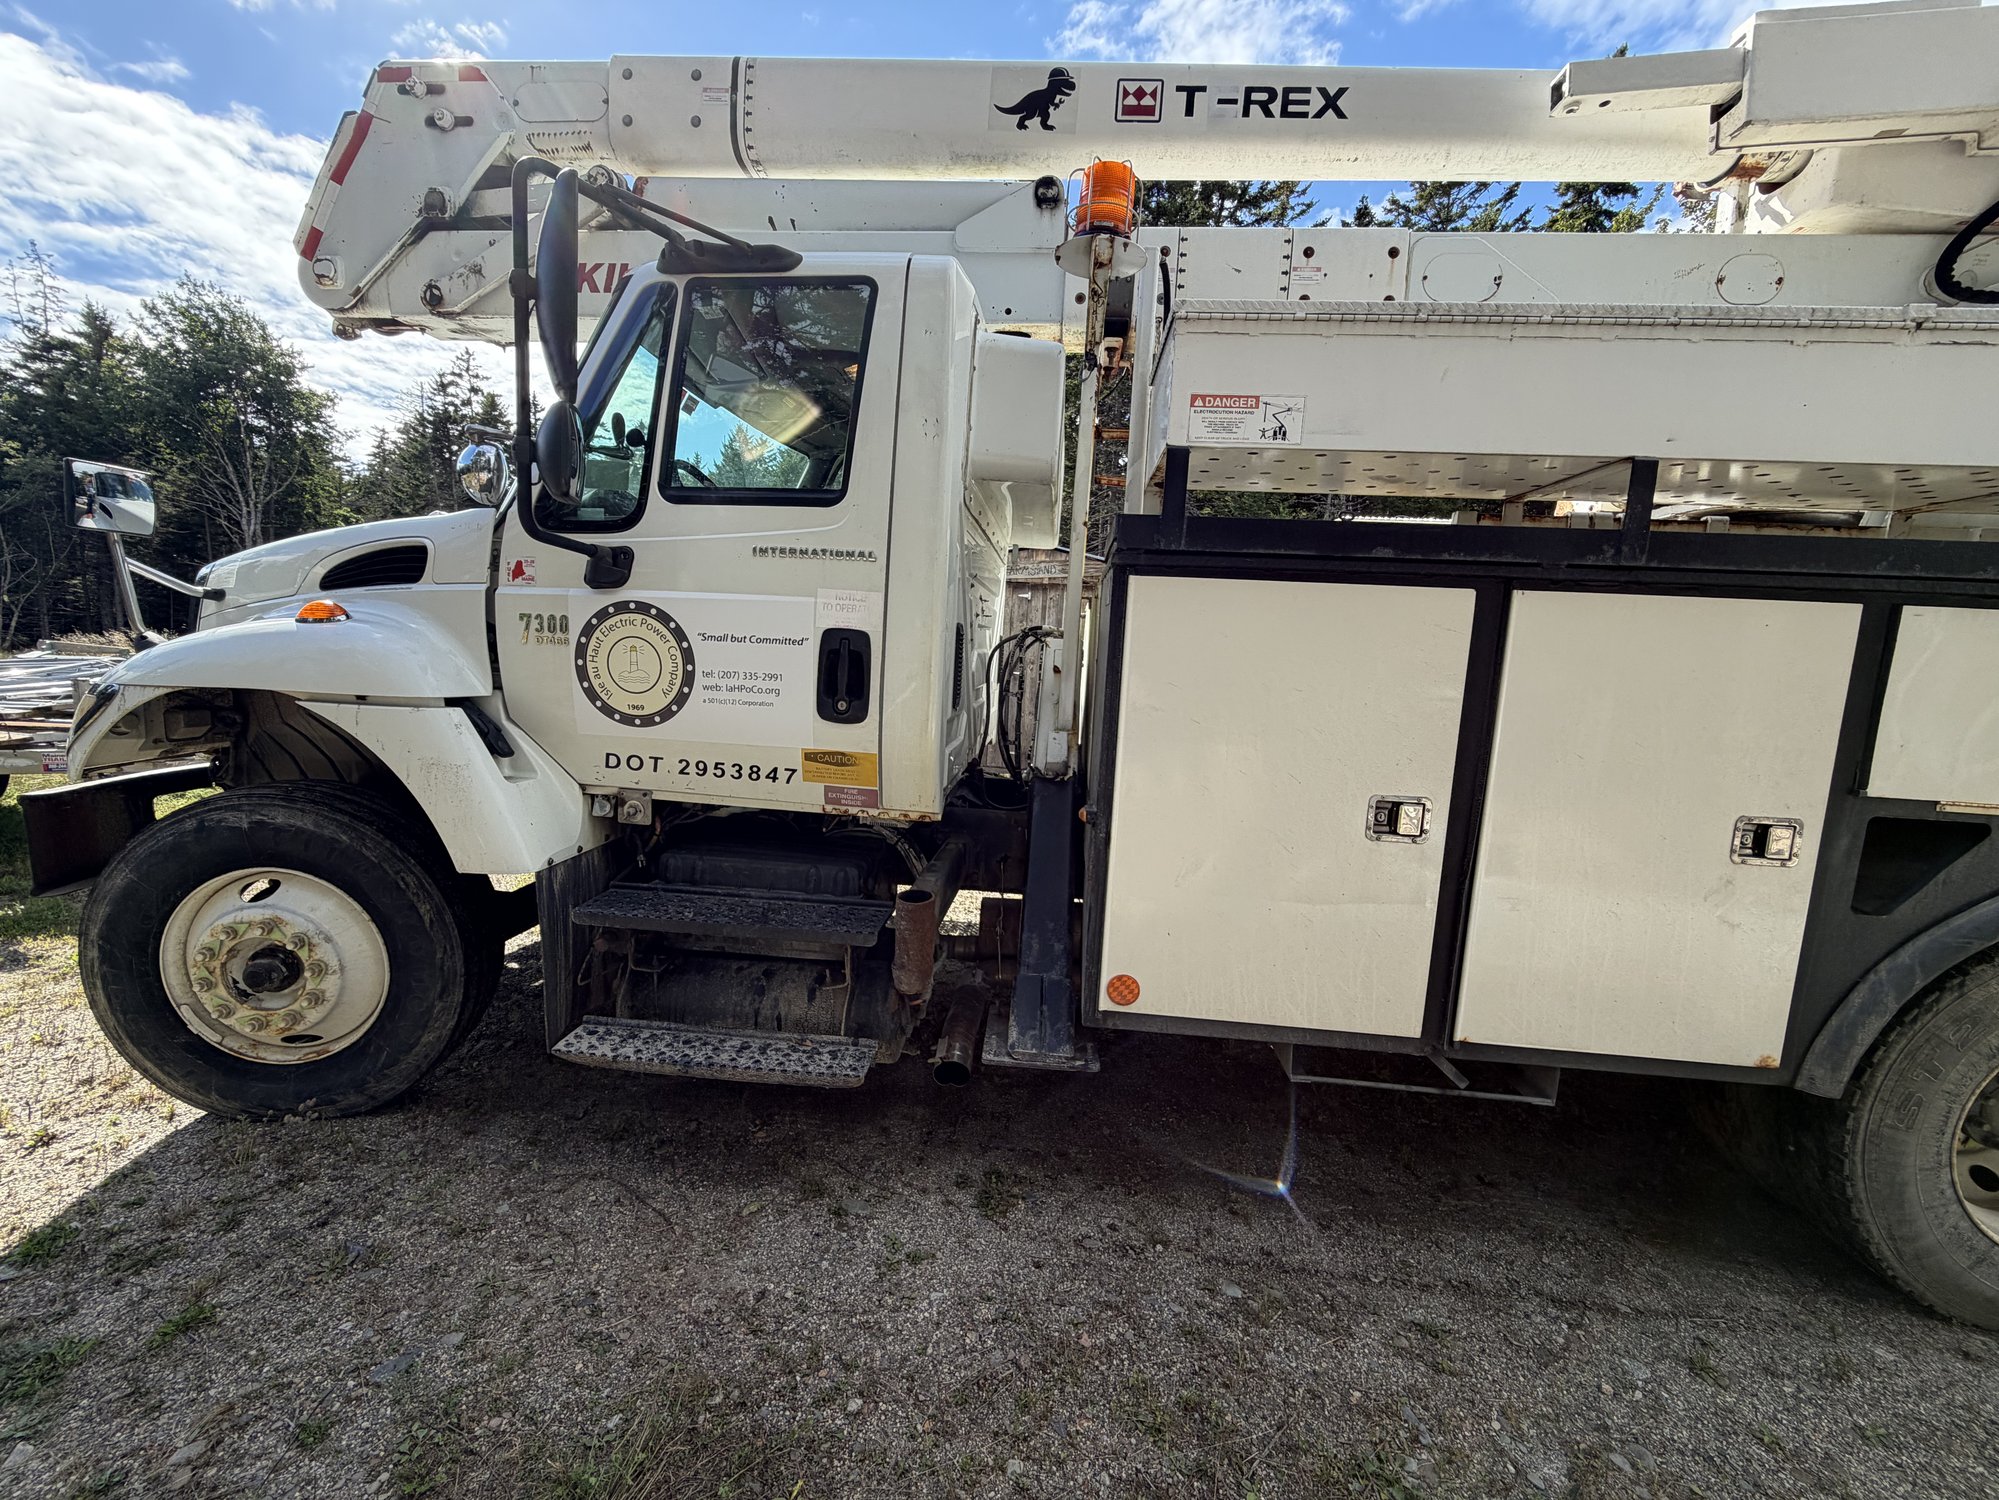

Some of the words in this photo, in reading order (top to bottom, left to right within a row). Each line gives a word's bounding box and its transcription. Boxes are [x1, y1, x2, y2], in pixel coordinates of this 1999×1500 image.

[1205, 397, 1256, 408] DANGER
[752, 545, 877, 562] INTERNATIONAL
[822, 602, 833, 611] TO
[518, 612, 570, 645] 7300
[599, 616, 638, 638] Electric
[640, 617, 671, 645] Power
[730, 634, 747, 643] but
[588, 636, 604, 663] Haut
[591, 666, 602, 681] au
[661, 645, 679, 699] Company
[702, 670, 716, 679] tel:
[717, 670, 740, 681] (207)
[742, 672, 783, 682] 335-2991
[597, 681, 614, 701] Isle
[702, 683, 724, 692] web:
[707, 698, 737, 706] 501(c)(12)
[738, 699, 774, 707] Corporation
[817, 753, 859, 764] CAUTION
[604, 752, 664, 772] DOT
[678, 758, 798, 785] 2953847
